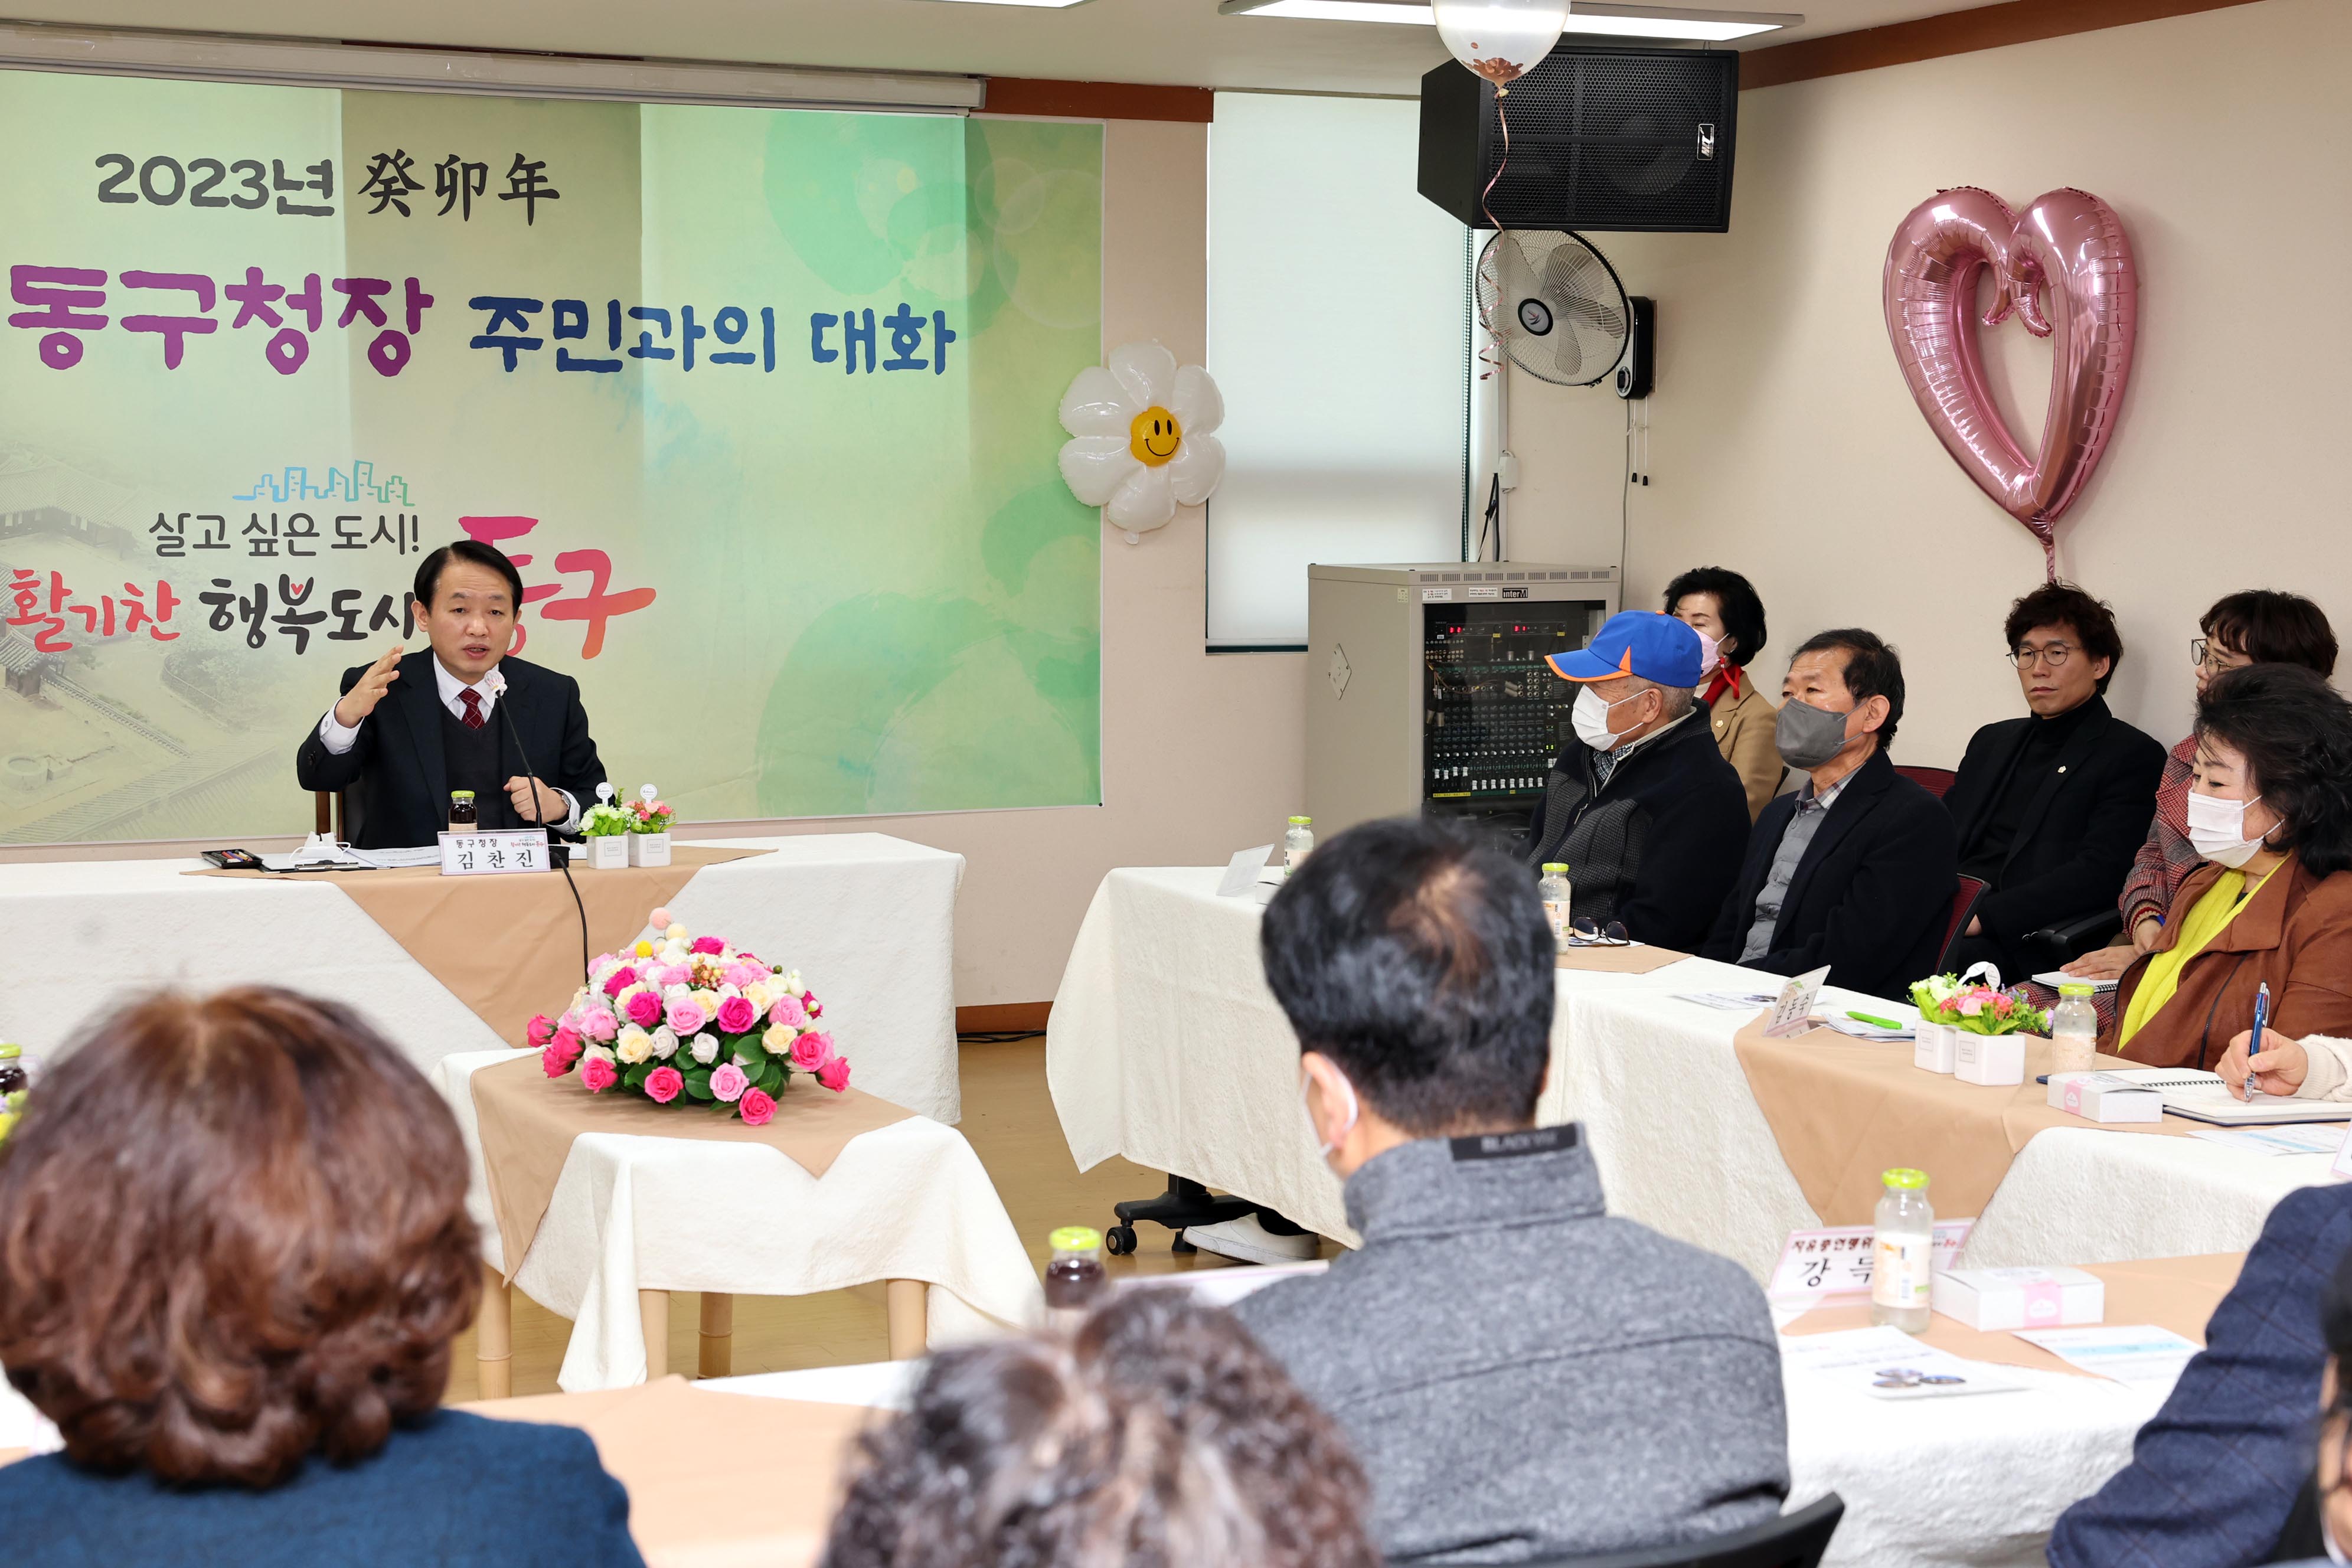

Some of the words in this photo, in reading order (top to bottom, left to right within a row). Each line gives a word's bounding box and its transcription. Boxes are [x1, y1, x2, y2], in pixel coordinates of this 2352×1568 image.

[94, 153, 335, 217] 2023년
[357, 148, 560, 226] 癸卯年
[8, 264, 435, 377] 동구청장
[468, 296, 775, 374] 주민과의
[811, 302, 956, 375] 대화
[149, 512, 231, 557] 살고
[241, 512, 320, 557] 싶은
[331, 512, 419, 556] 도시!
[5, 569, 181, 653] 활기찬
[198, 574, 415, 655] 행복도시
[456, 838, 497, 848] 동구청장
